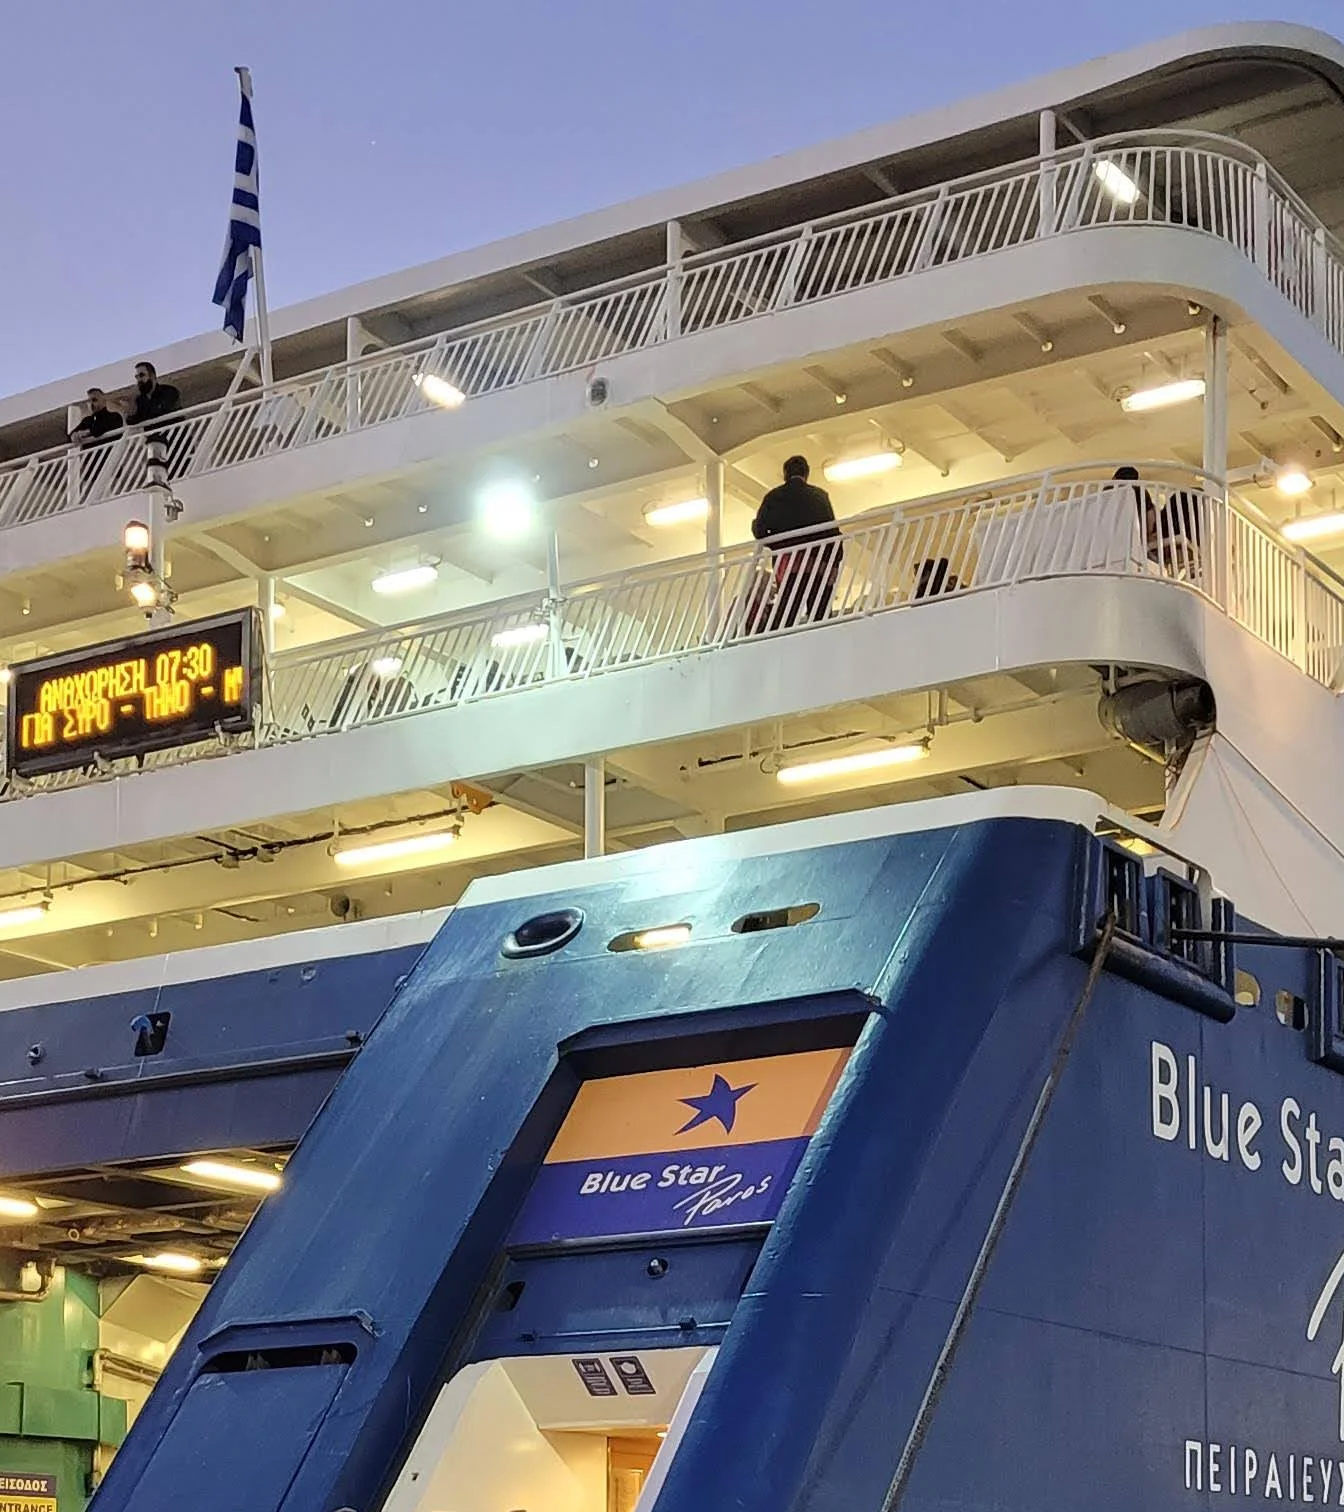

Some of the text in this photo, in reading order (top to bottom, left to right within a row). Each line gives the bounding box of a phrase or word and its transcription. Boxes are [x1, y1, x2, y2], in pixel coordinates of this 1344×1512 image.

[40, 643, 212, 713] ΑΝΑΧΩΡΗΣΗ 07:30
[22, 711, 54, 747] ΓΙΑ
[1150, 1040, 1263, 1171] Blue
[579, 1162, 727, 1196] Blue Star
[672, 1173, 773, 1226] Paros
